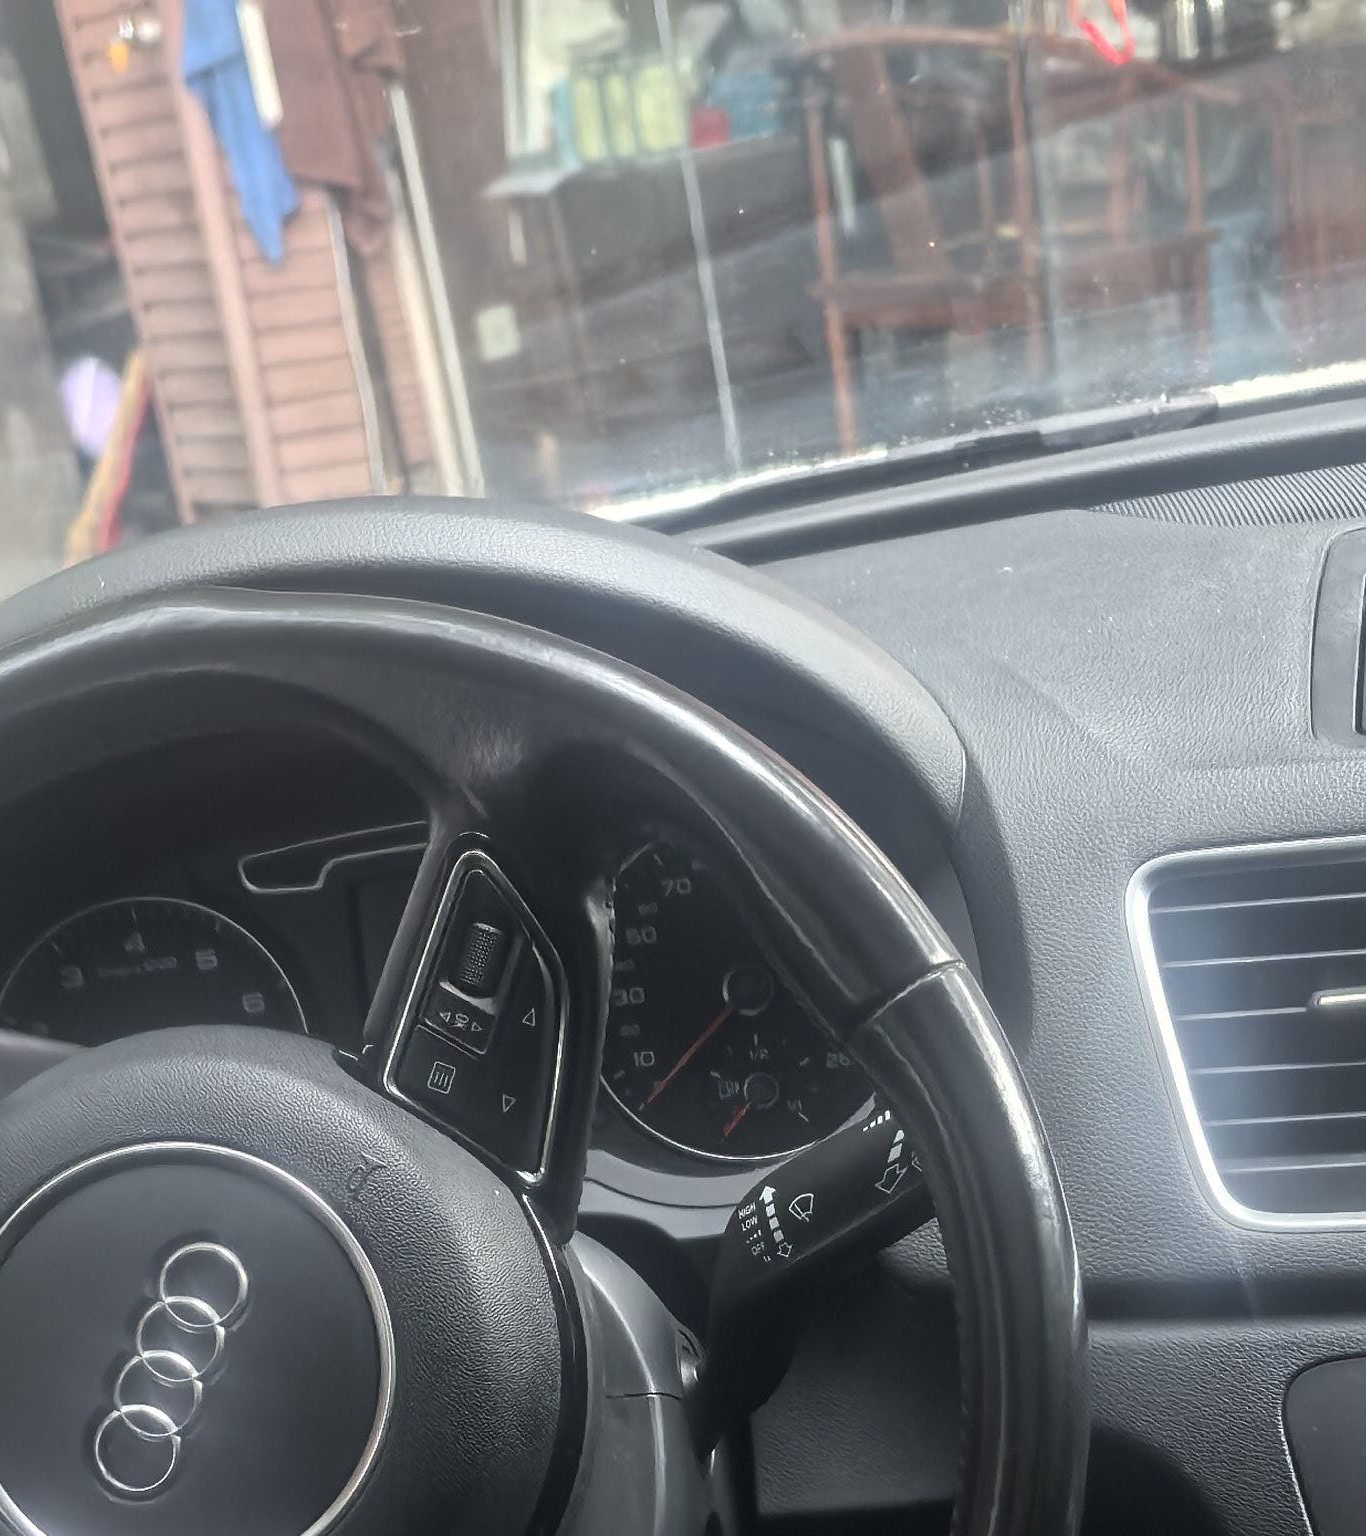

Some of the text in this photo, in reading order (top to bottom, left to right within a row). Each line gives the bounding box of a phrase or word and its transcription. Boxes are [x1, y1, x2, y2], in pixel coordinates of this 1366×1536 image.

[634, 1051, 655, 1067] 10
[738, 1202, 756, 1219] HIGH
[741, 1216, 758, 1231] LOW
